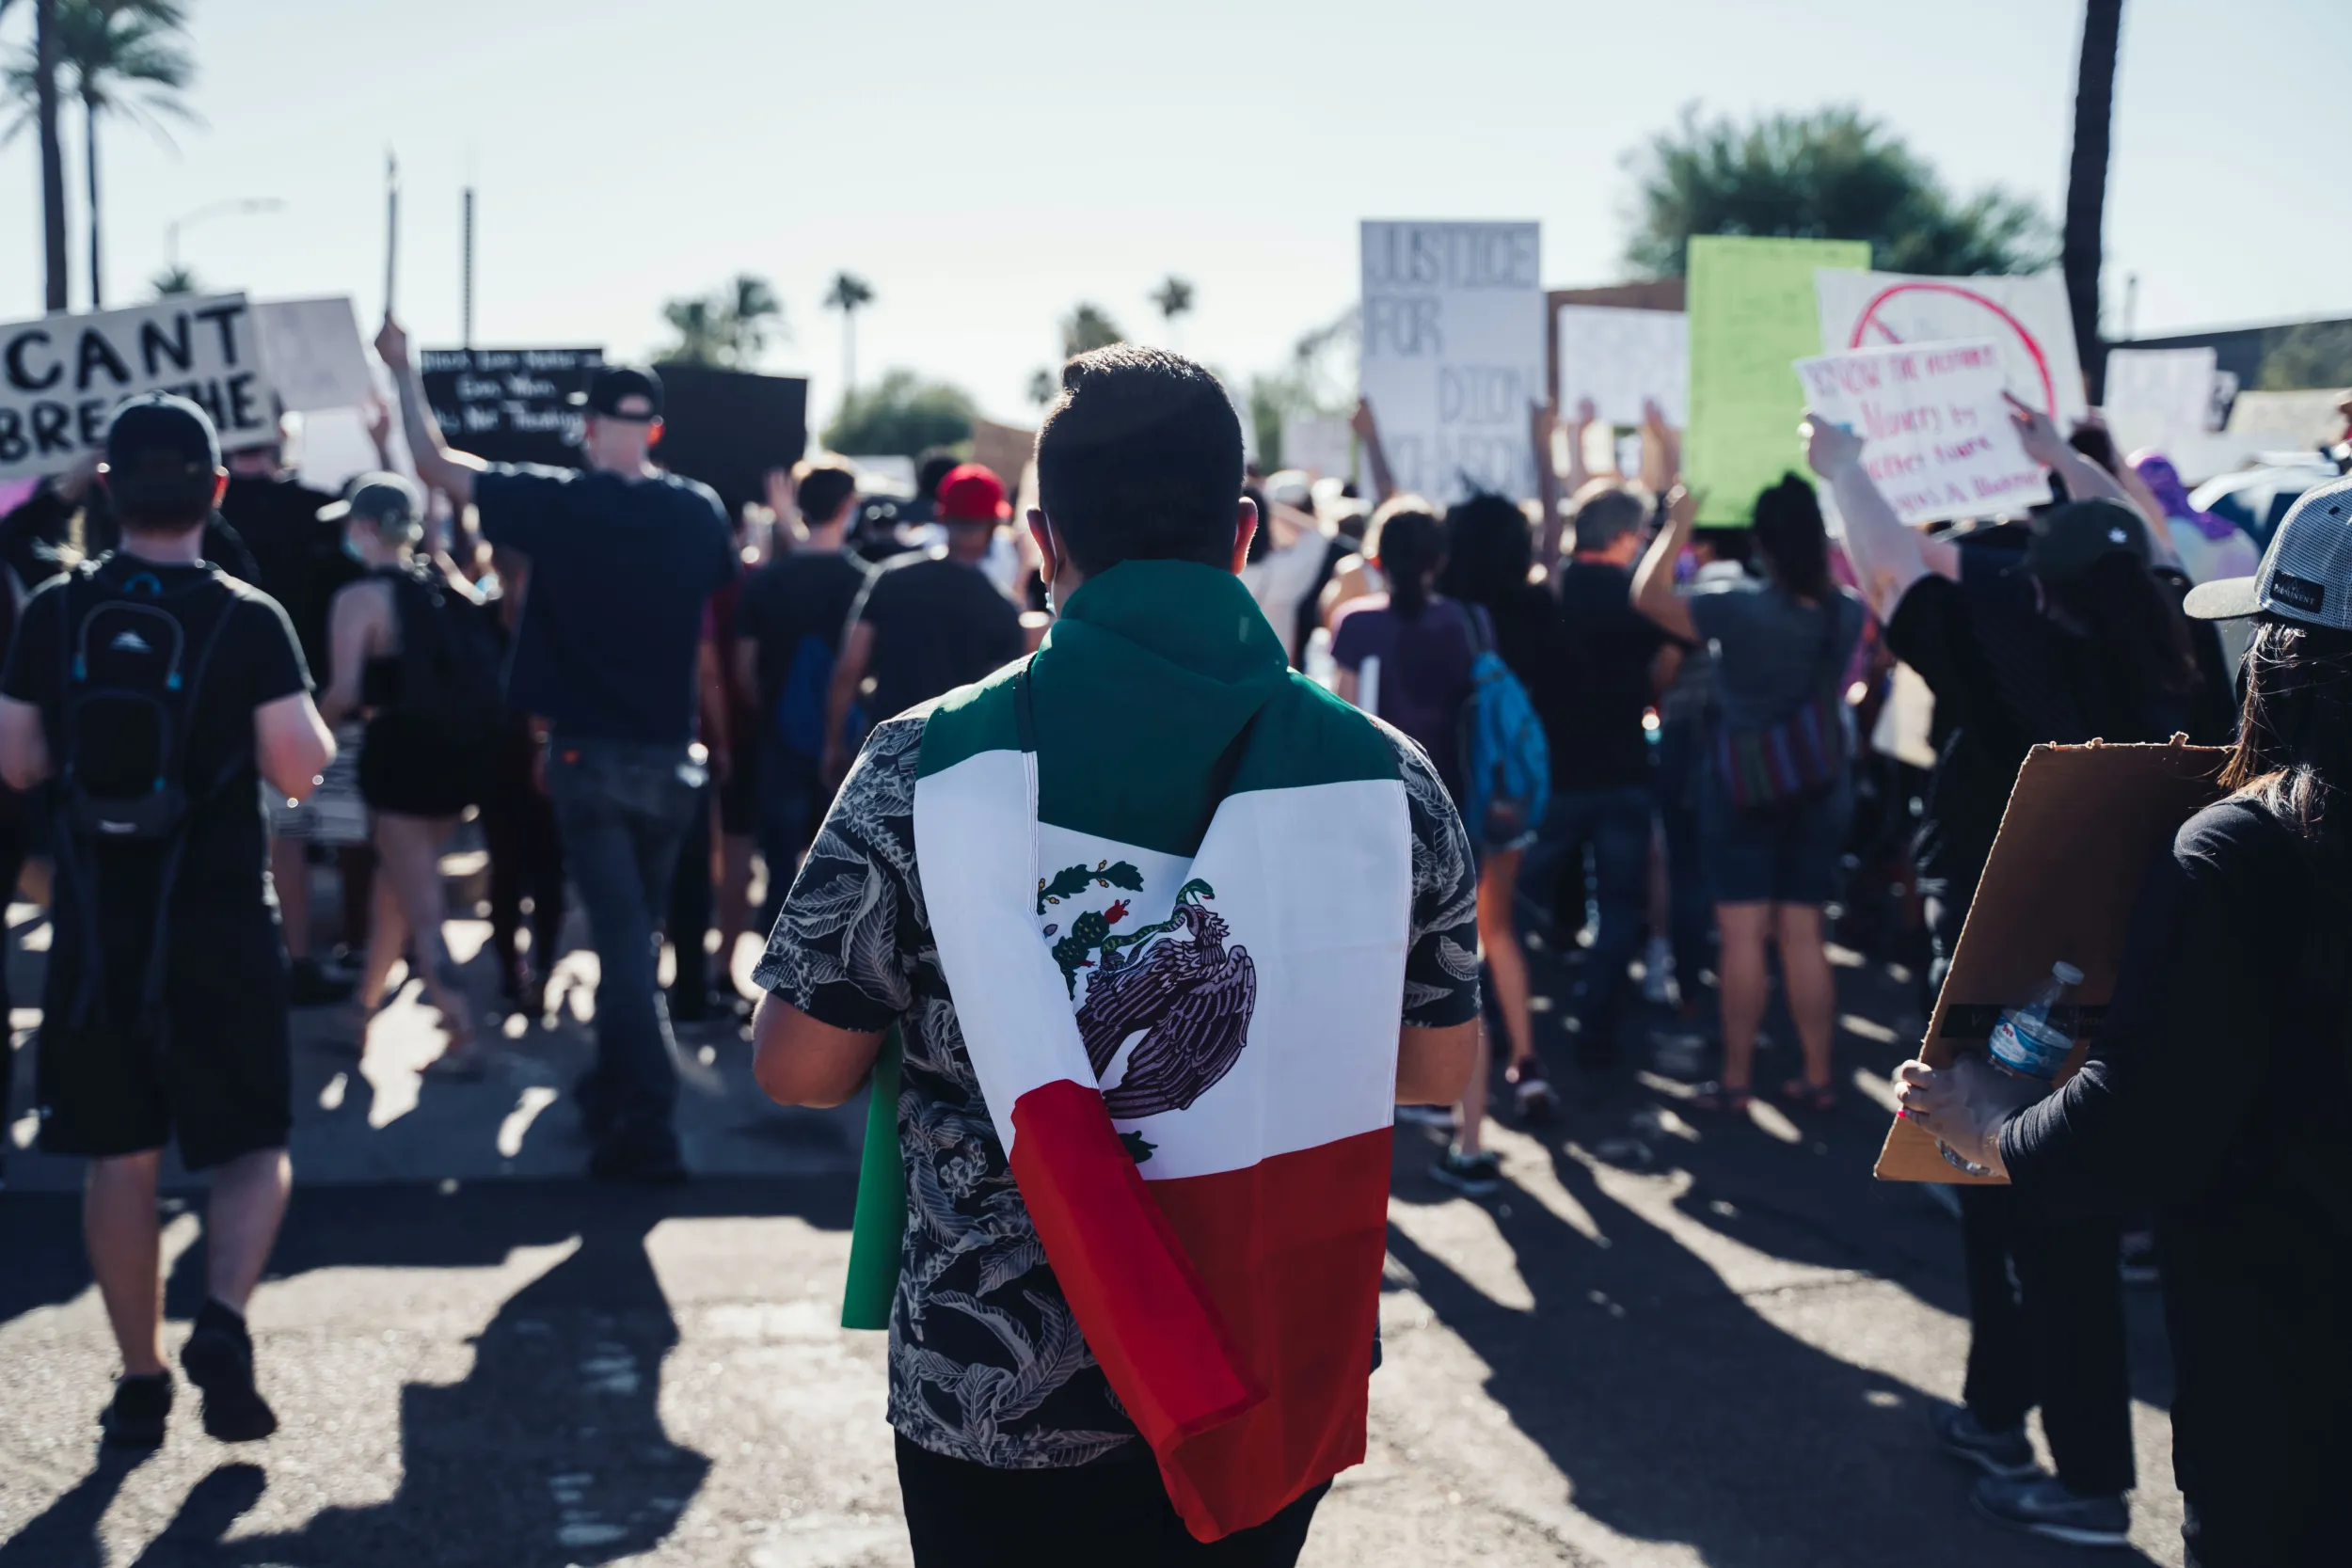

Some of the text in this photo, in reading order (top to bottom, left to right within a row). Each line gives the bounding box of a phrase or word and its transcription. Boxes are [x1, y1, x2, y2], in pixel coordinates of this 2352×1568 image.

[1364, 224, 1538, 289] JUSTICE
[4, 303, 246, 392] CANT
[1367, 294, 1445, 358] FOR
[0, 372, 266, 463] BREHE
